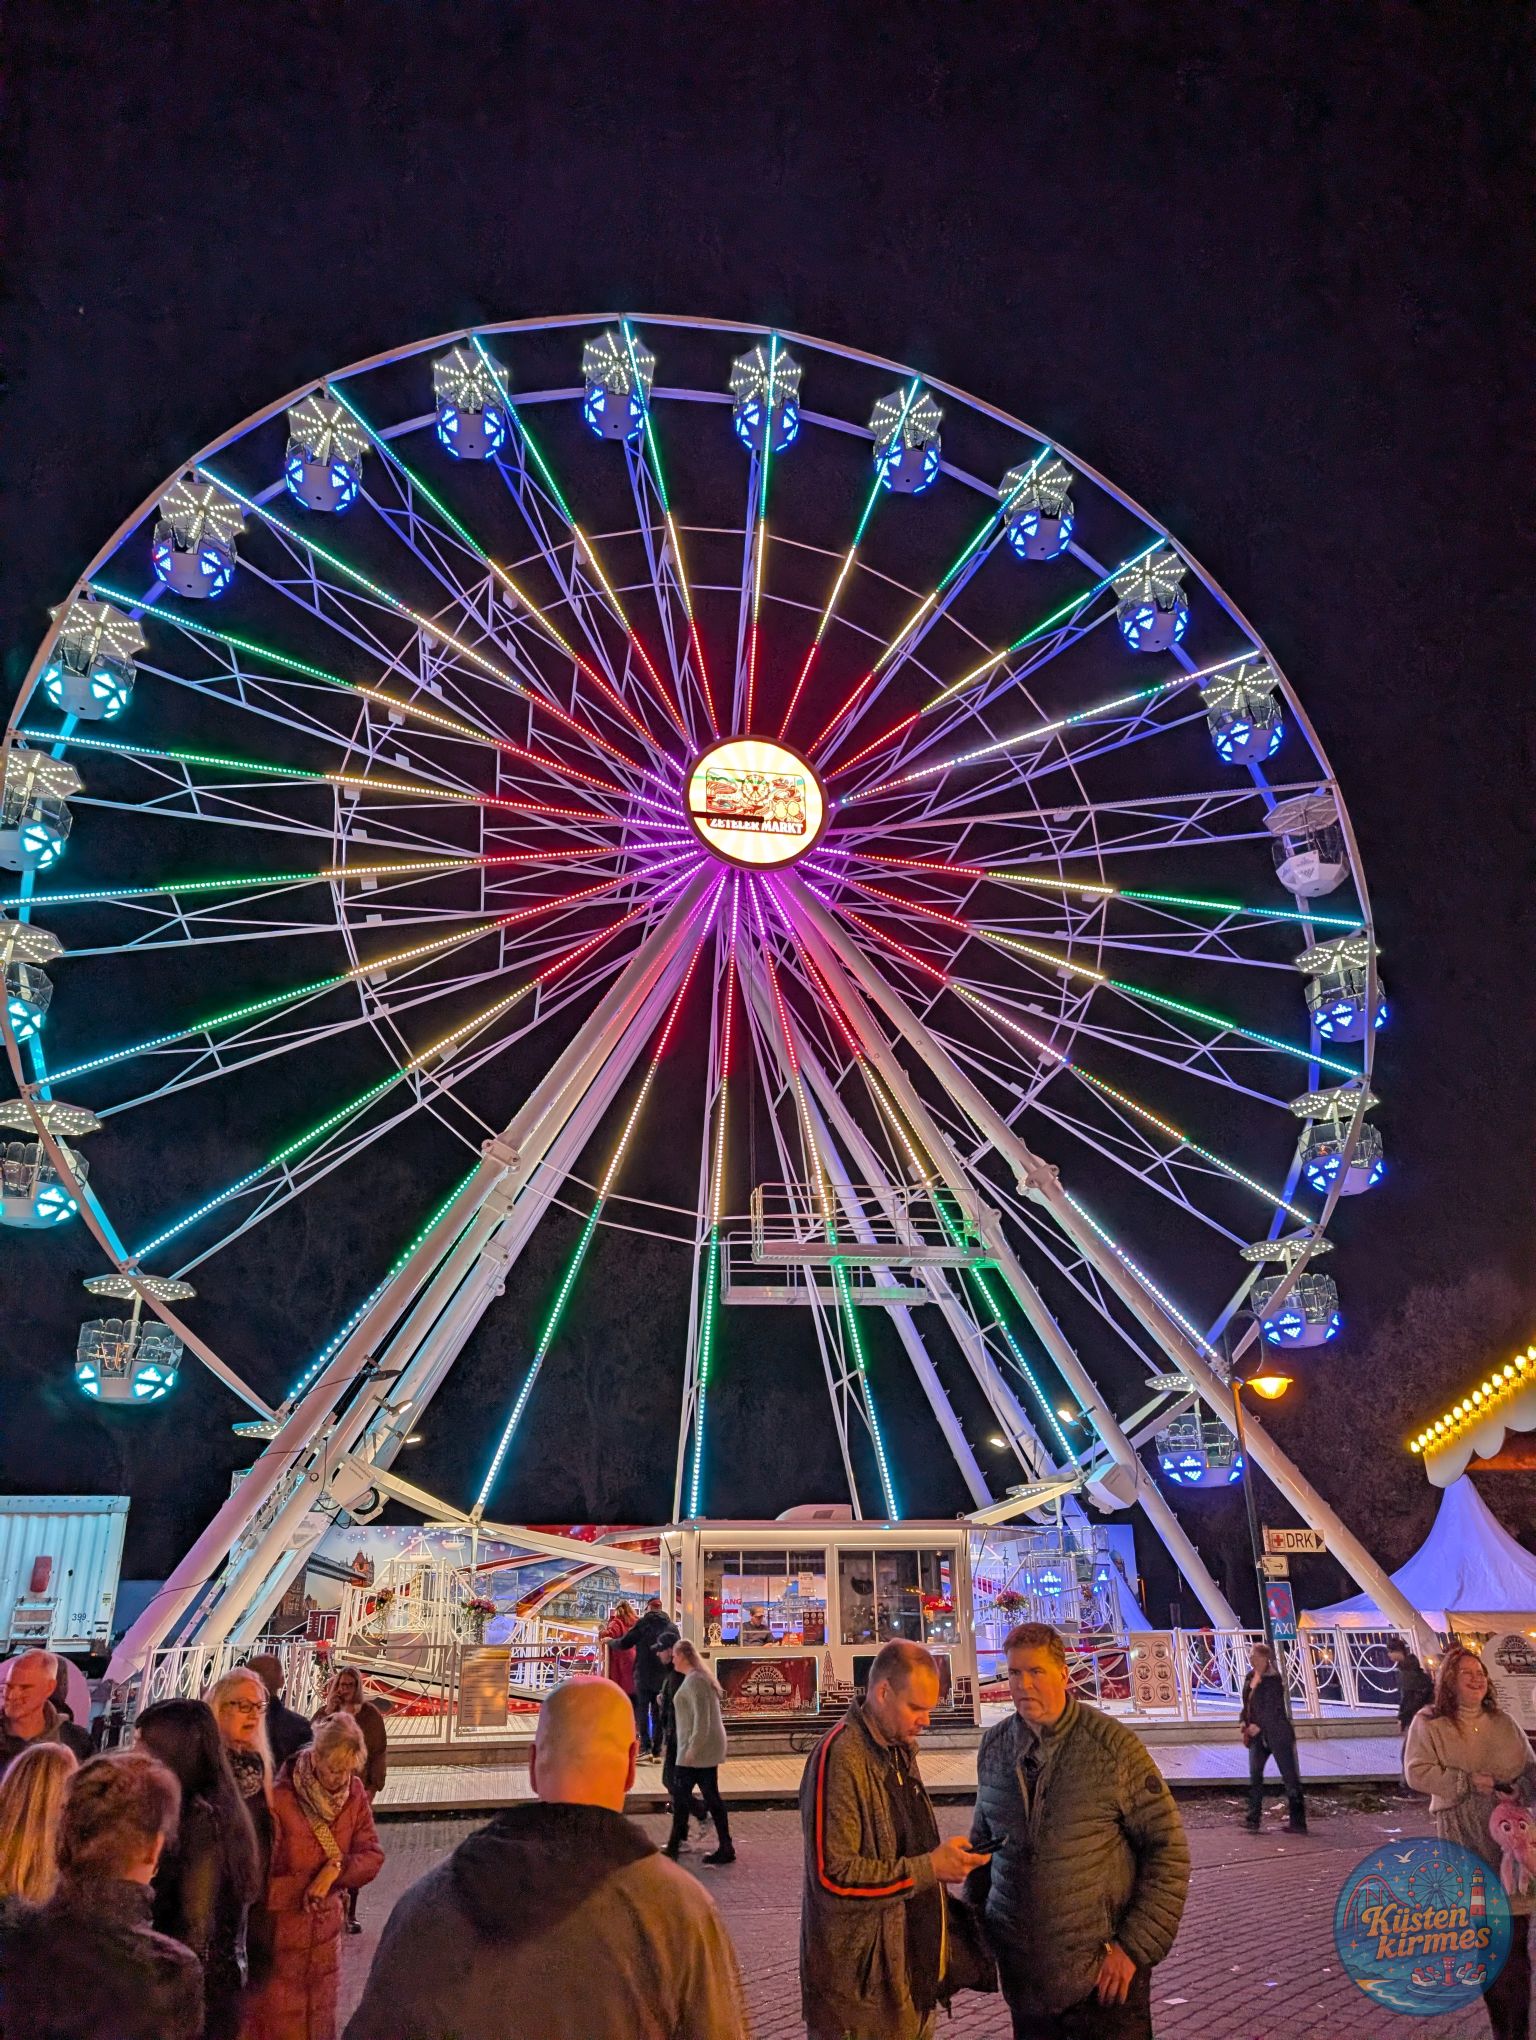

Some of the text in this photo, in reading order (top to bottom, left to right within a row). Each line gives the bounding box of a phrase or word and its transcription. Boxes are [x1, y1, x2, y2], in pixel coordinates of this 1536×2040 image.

[761, 821, 804, 834] MARKT
[1286, 1532, 1314, 1548] DRK
[1271, 1622, 1293, 1634] AXI
[741, 1682, 792, 1696] 360
